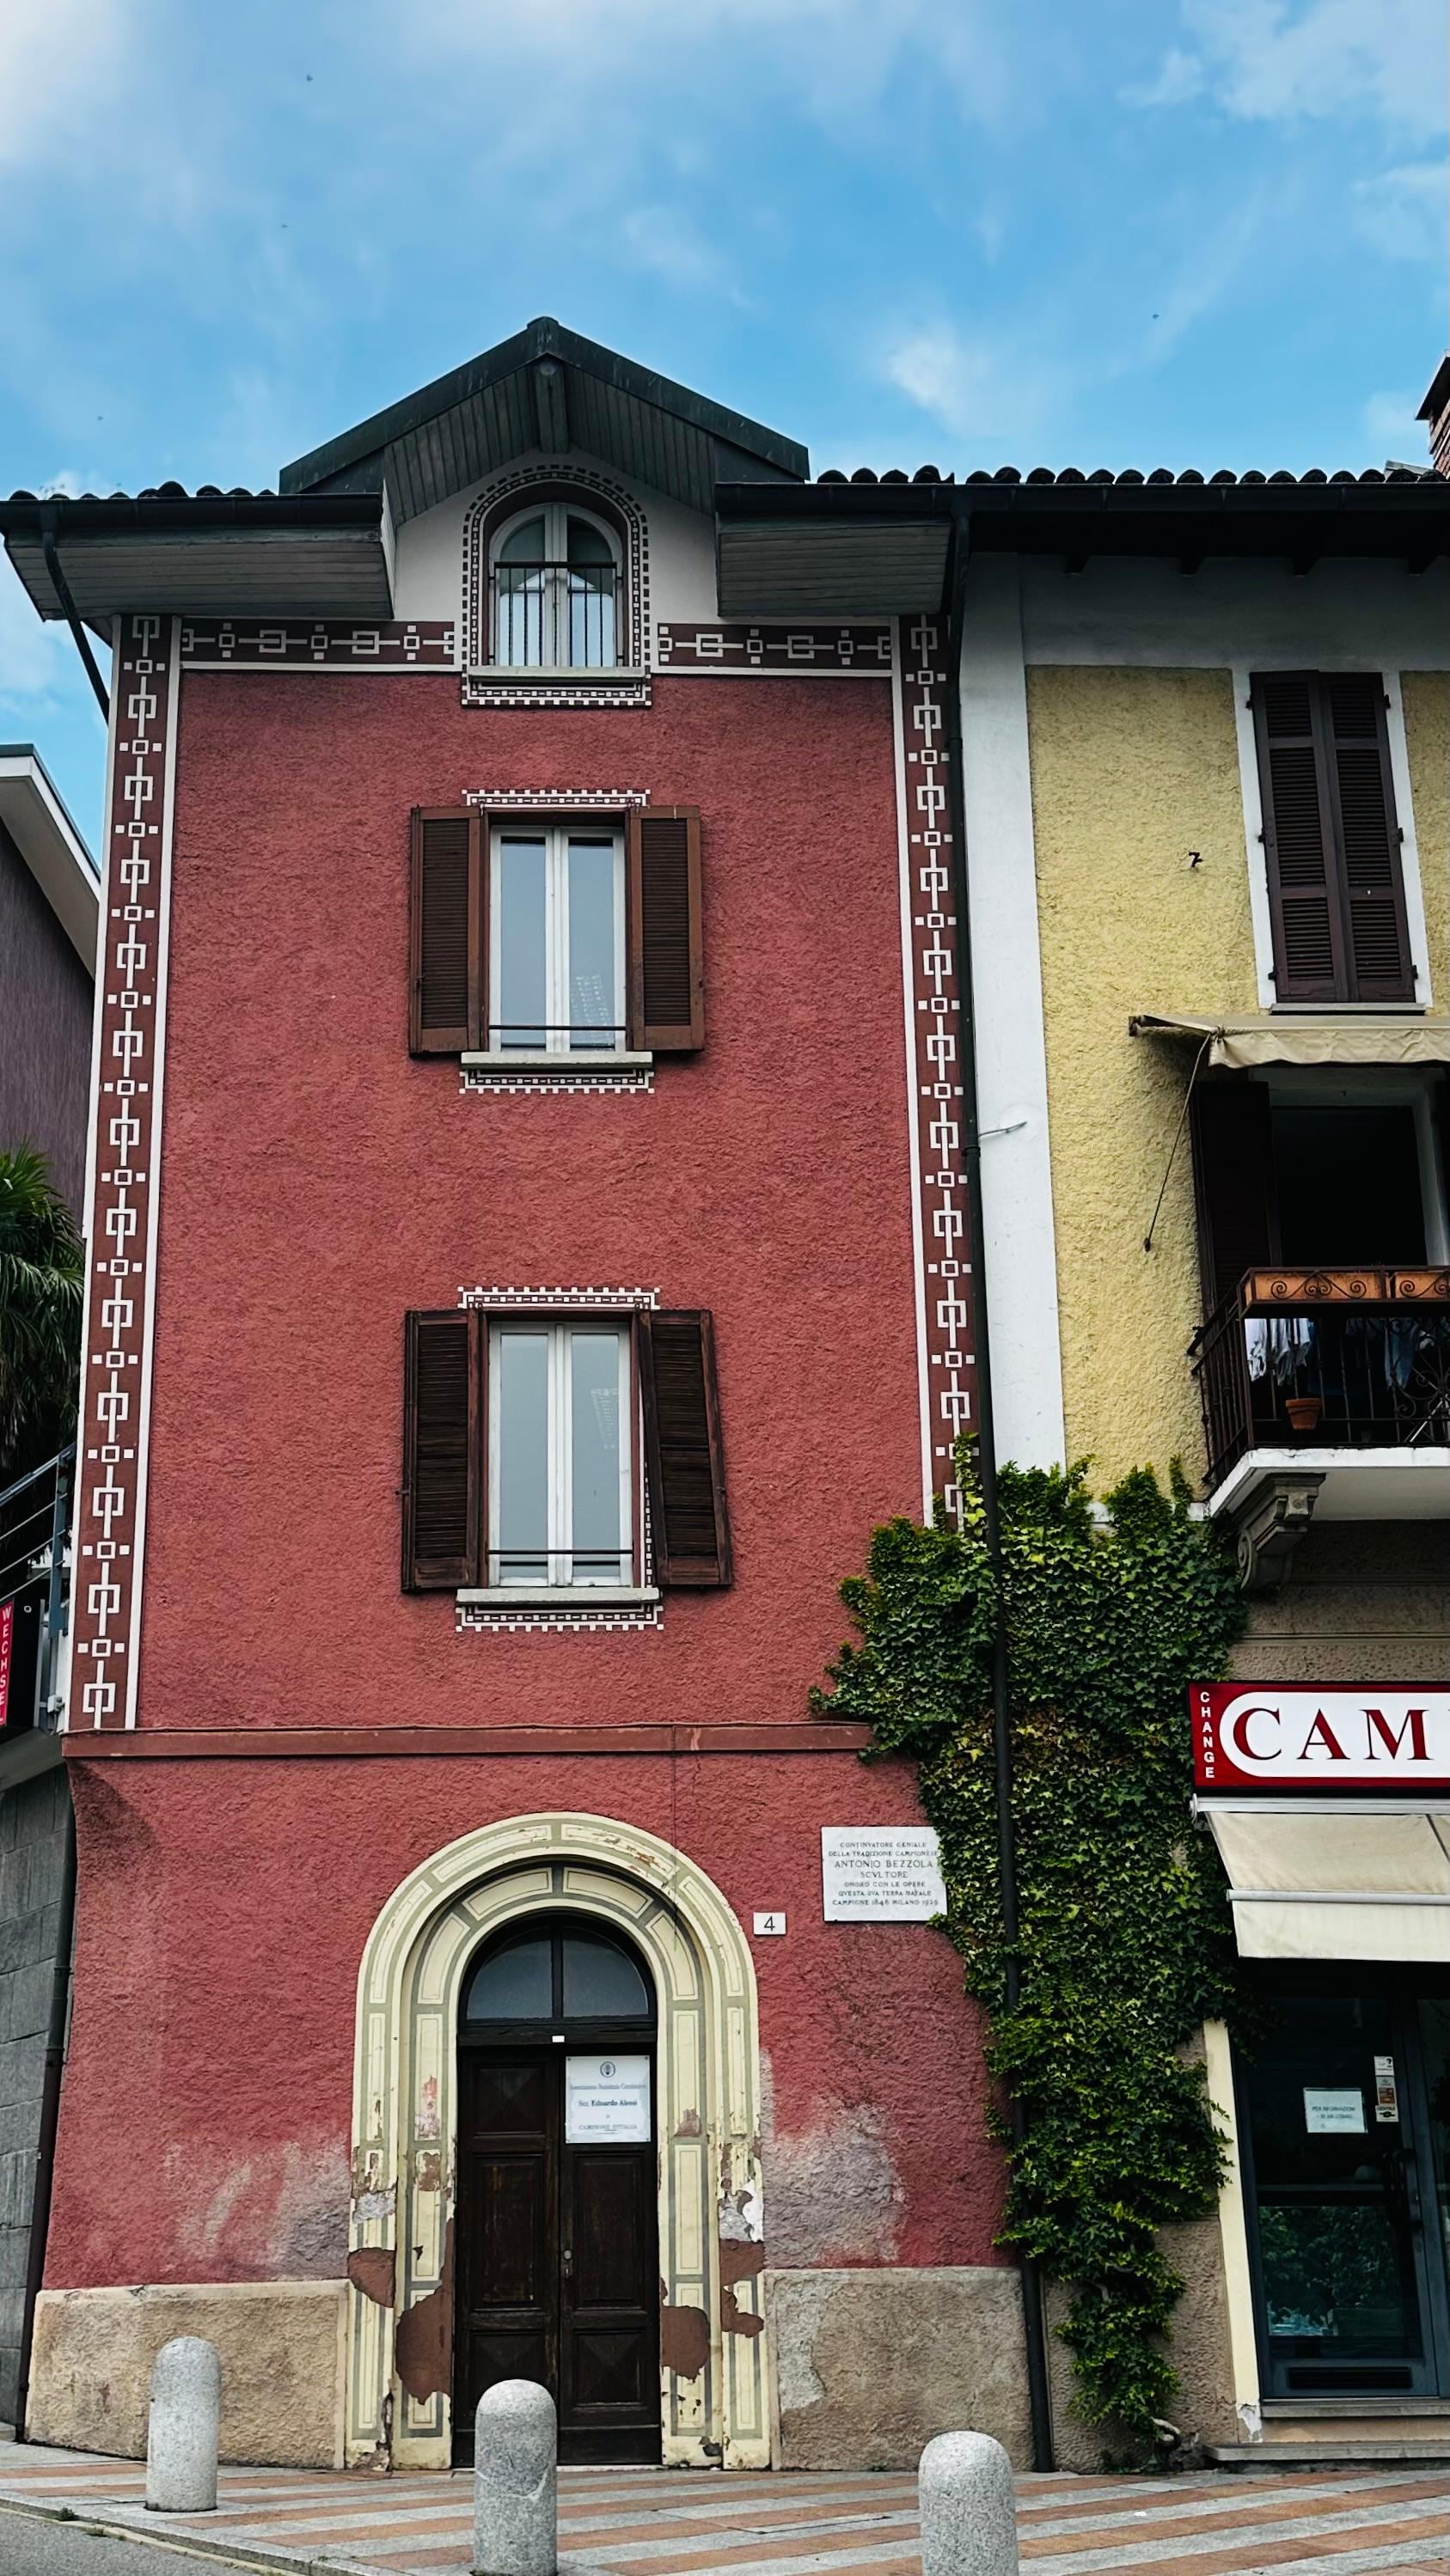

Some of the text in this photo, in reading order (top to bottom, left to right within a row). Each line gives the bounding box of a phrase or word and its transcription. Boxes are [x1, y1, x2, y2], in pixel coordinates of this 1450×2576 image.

[1200, 1691, 1215, 1779] CHANGE
[1233, 1707, 1450, 1761] CAM
[834, 1859, 933, 1869] ANTONIO BEZZOLA
[763, 1916, 775, 1932] 4
